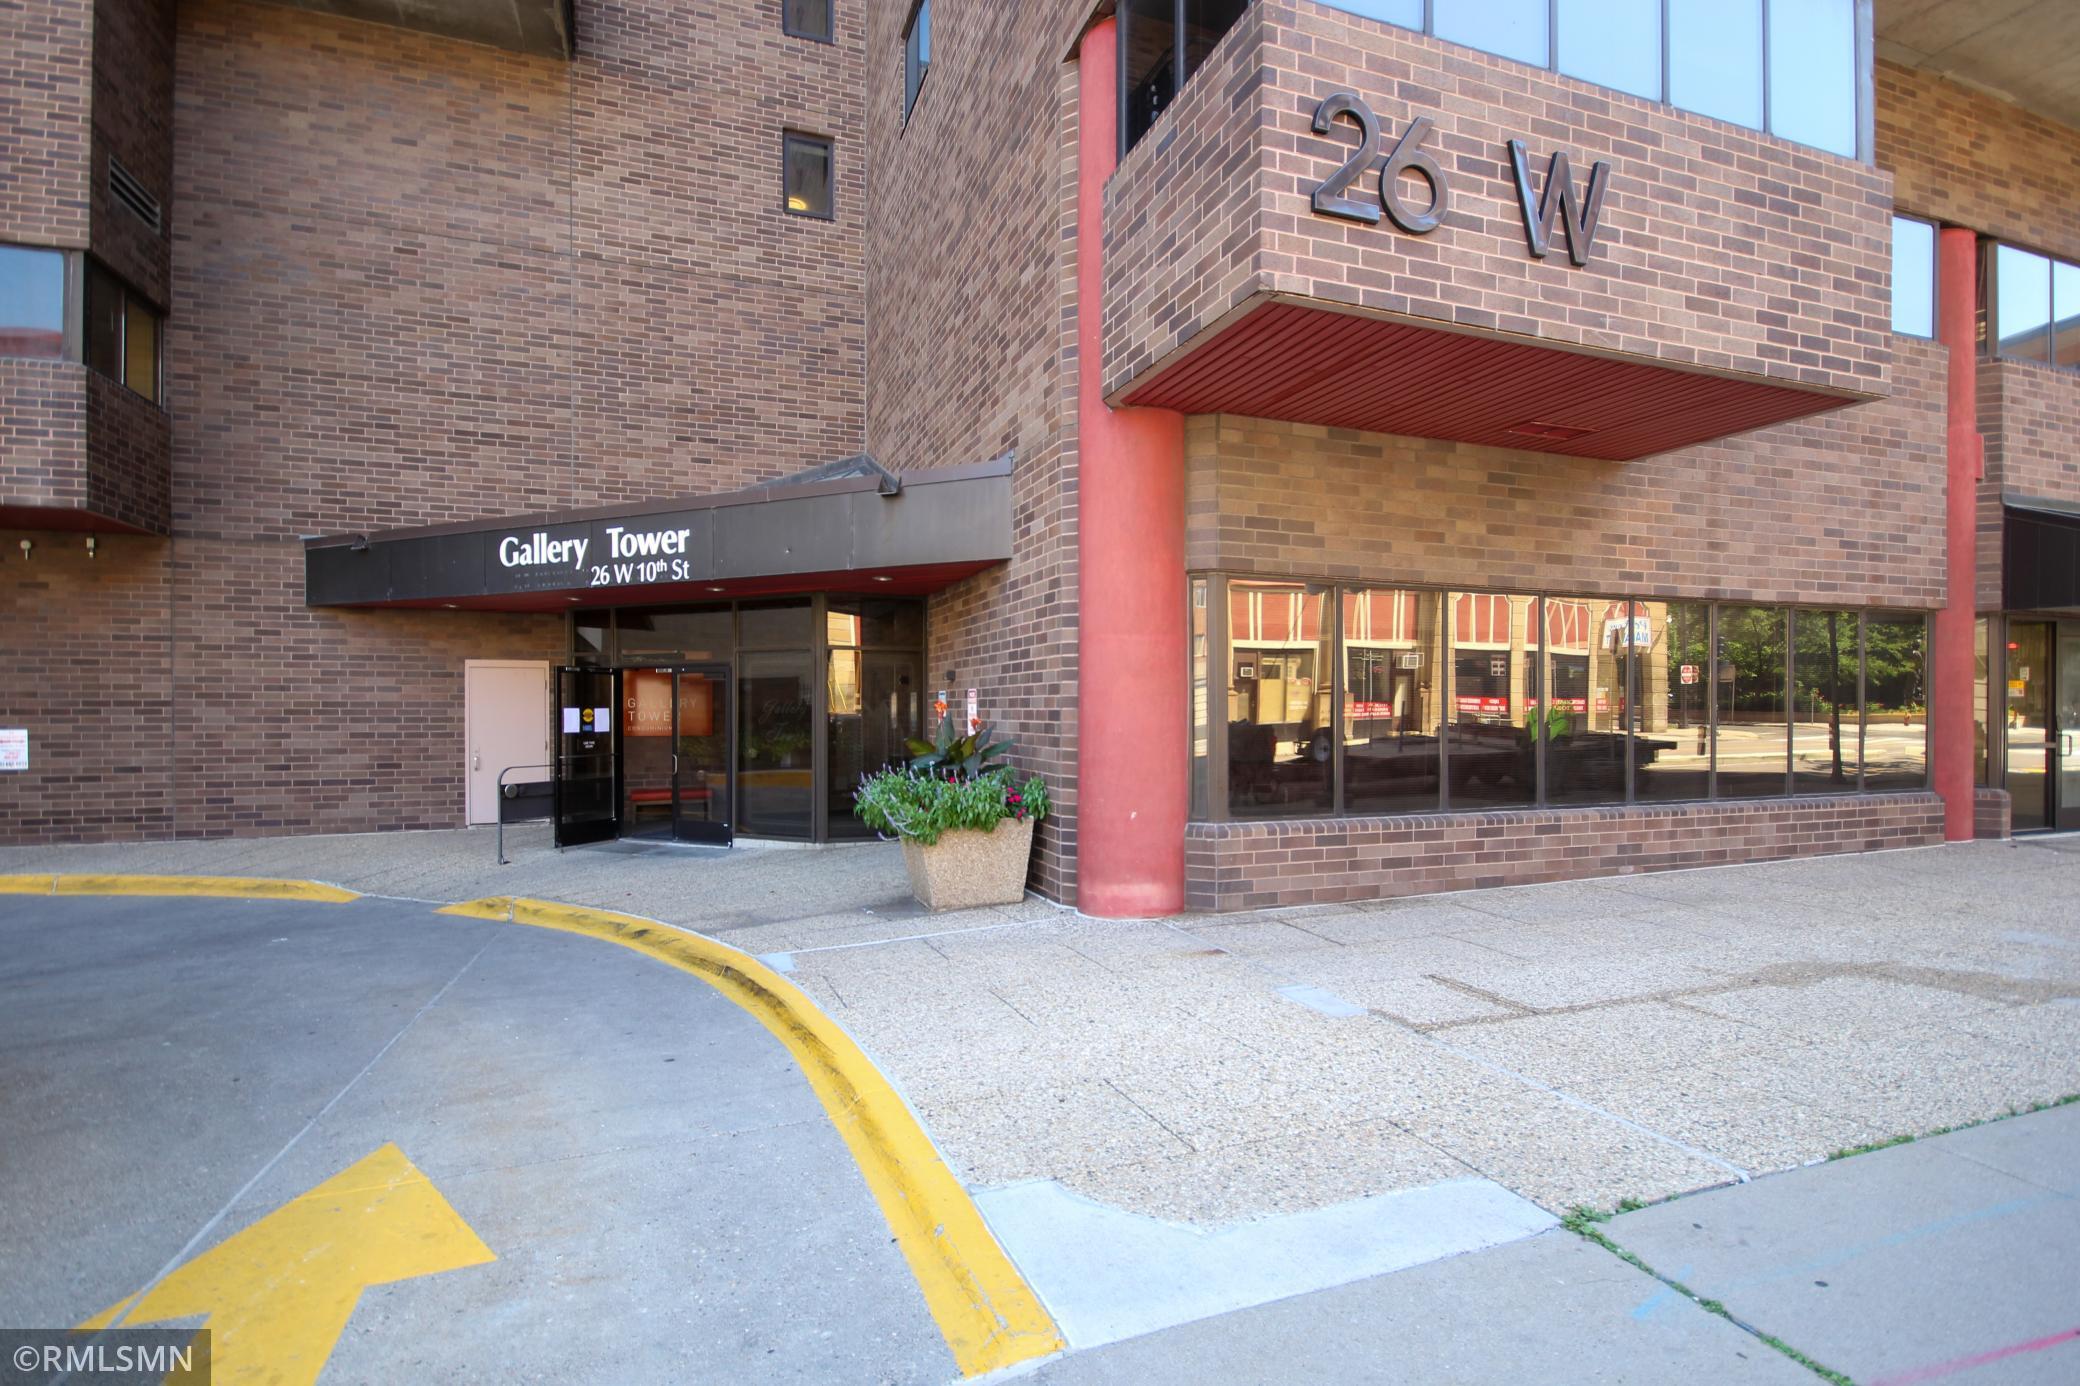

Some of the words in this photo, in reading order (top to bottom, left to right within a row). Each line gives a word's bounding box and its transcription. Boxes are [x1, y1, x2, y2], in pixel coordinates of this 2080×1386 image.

[1311, 92, 1449, 236] 26
[1507, 139, 1612, 267] W
[499, 532, 589, 570] Gallery
[606, 526, 690, 558] Tower
[590, 565, 611, 586] 26
[614, 562, 634, 584] W
[636, 558, 668, 582] 10th
[671, 558, 690, 581] St
[627, 711, 681, 722] TOWE
